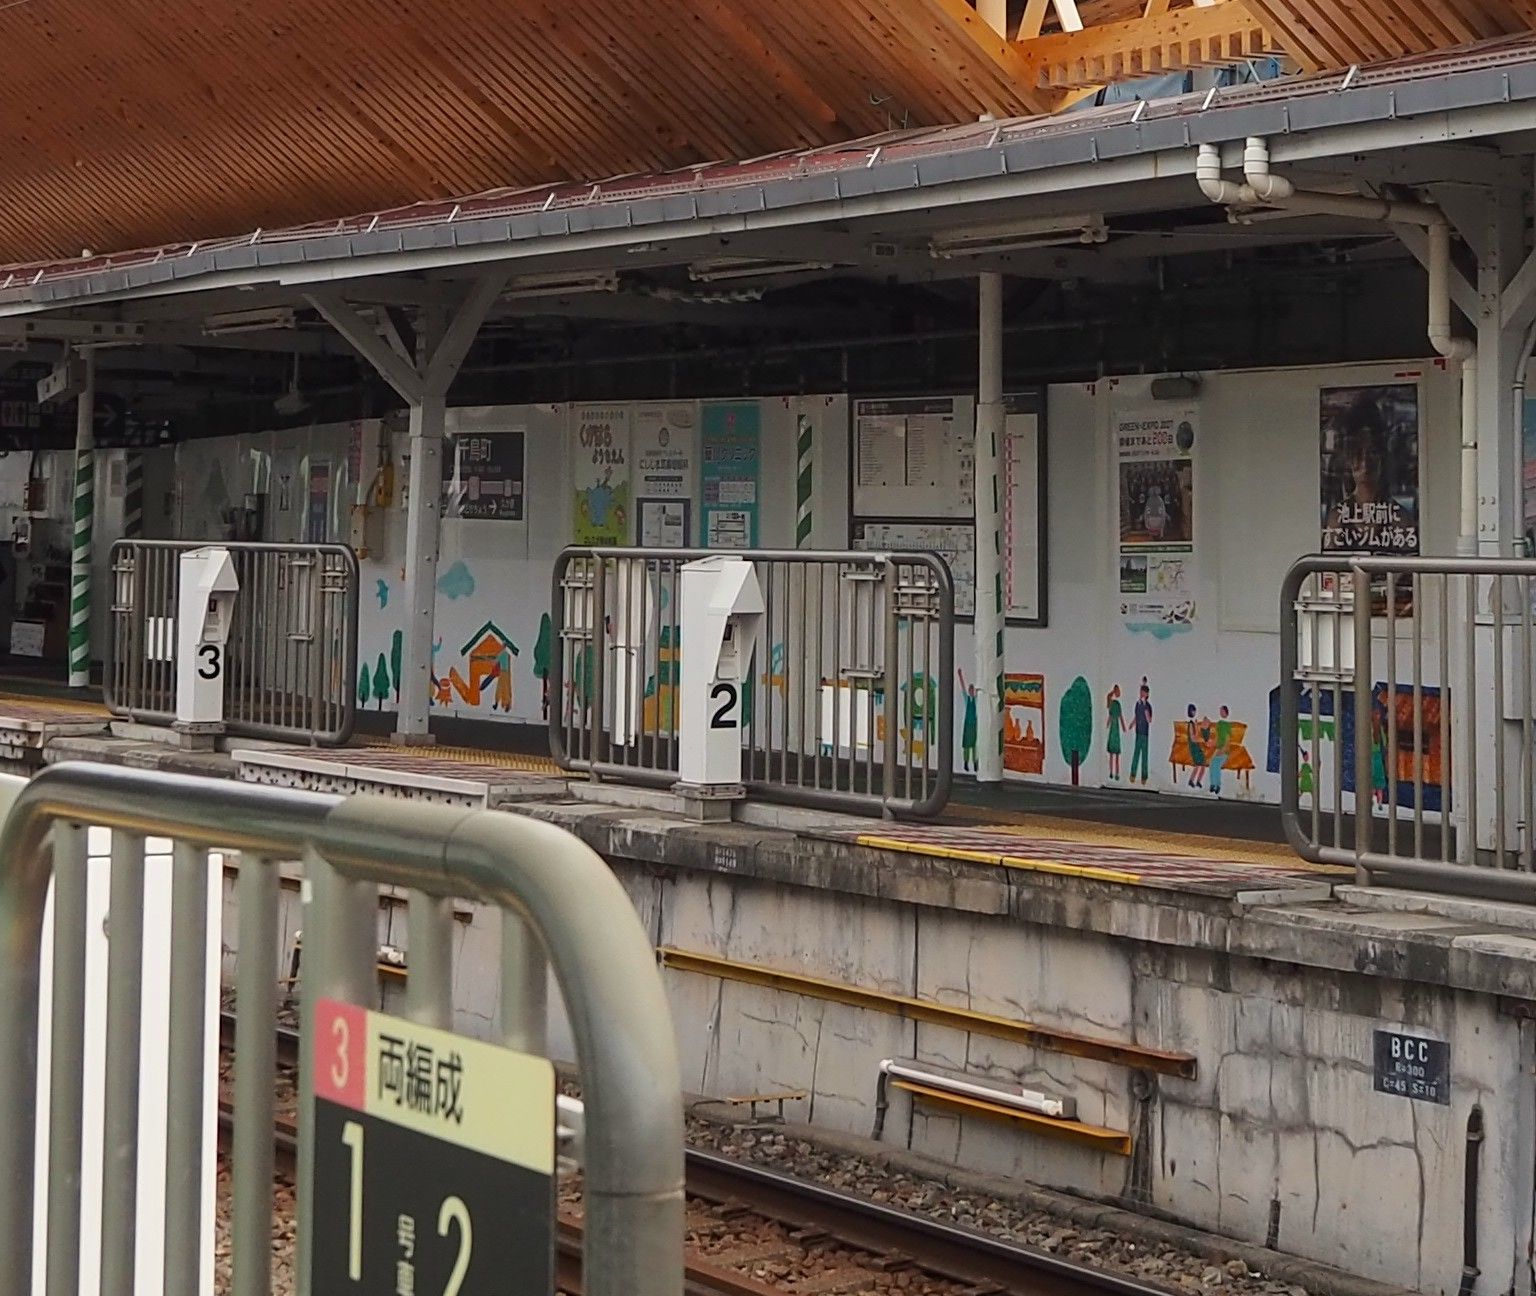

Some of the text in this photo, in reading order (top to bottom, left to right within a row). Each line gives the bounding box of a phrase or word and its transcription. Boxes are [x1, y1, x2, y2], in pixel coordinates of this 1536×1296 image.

[1336, 502, 1401, 524] 池上駅前に
[1322, 526, 1418, 549] すごいジムがある
[198, 645, 220, 679] 3
[710, 683, 737, 729] 2
[1391, 1036, 1429, 1063] BCC
[331, 1016, 464, 1125] 3 両編成
[341, 1119, 365, 1283] 1
[436, 1195, 474, 1296] 2
